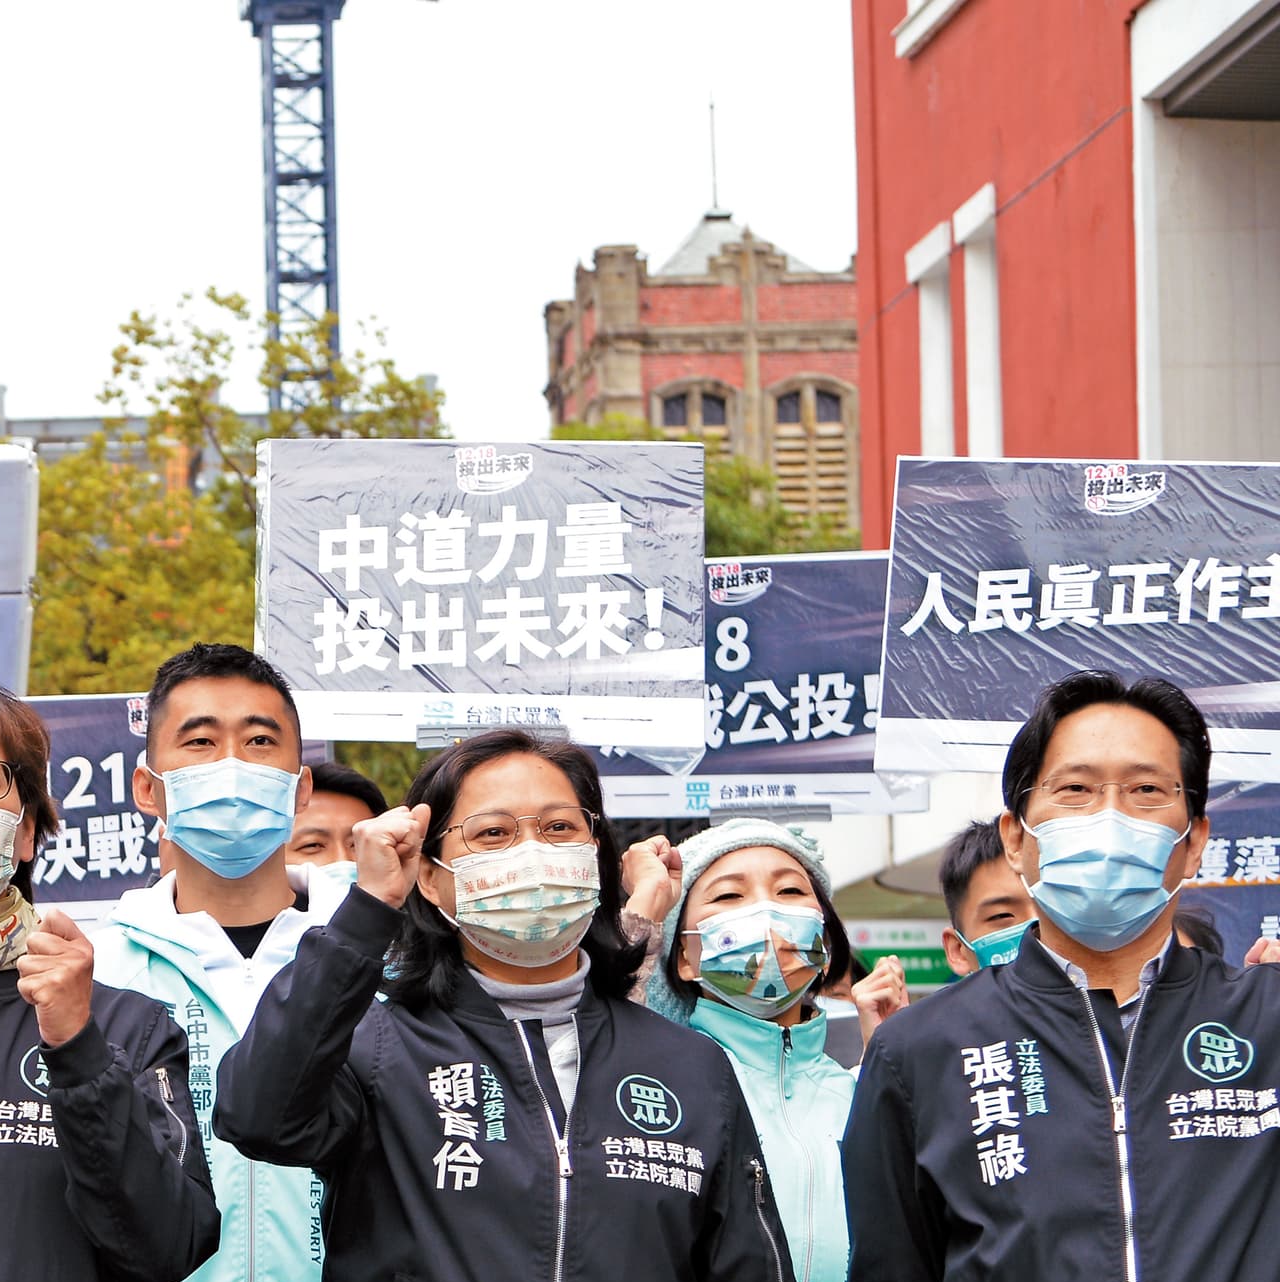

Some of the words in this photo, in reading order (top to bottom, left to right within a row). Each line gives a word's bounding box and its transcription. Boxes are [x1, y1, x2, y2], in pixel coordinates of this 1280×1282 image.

[458, 453, 532, 479] 投出未來
[1088, 474, 1162, 497] 投出未來
[318, 502, 634, 592] 中道力量
[708, 564, 740, 576] 12.18
[710, 568, 771, 590] 投出未來
[313, 582, 665, 676] 投出未來!
[686, 782, 712, 810] 眾
[185, 998, 212, 1113] 台中市黨部
[1198, 1031, 1243, 1075] 眾
[1015, 1038, 1049, 1116] 立法委員
[479, 1063, 507, 1143] 立法委員
[629, 1083, 672, 1127] 眾
[1165, 1088, 1280, 1116] 台灣民眾黨
[1168, 1107, 1280, 1140] 立法院黨團
[600, 1136, 705, 1171] 台灣民眾黨
[605, 1158, 704, 1198] 立法院黨團
[310, 1216, 322, 1265] PARTY
